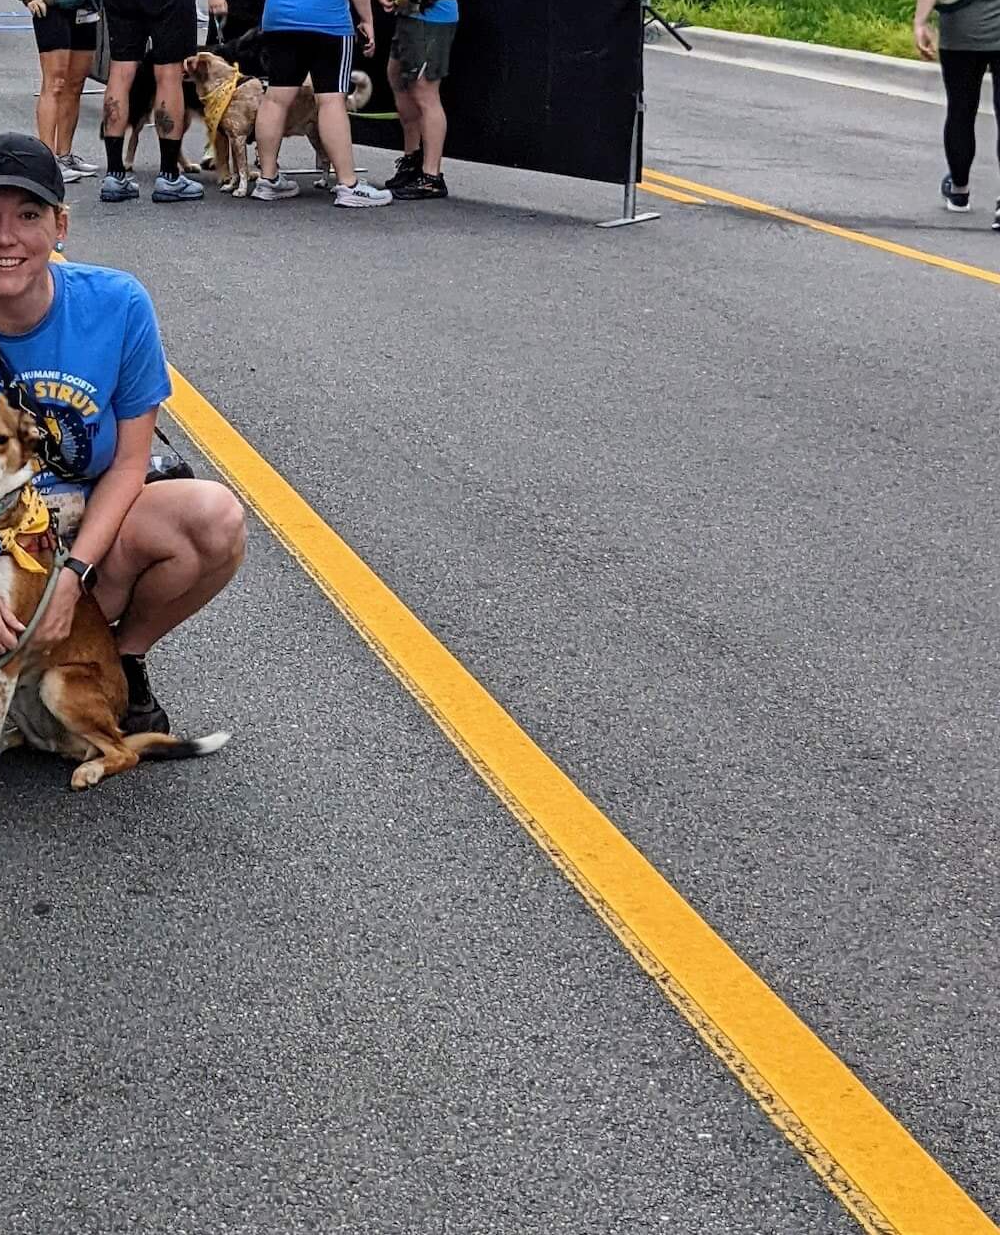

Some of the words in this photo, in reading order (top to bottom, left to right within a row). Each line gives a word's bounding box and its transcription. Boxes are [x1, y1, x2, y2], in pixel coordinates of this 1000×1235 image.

[21, 370, 61, 380] HUMANE
[62, 373, 98, 394] SOCIETY
[34, 380, 100, 417] STRUT
